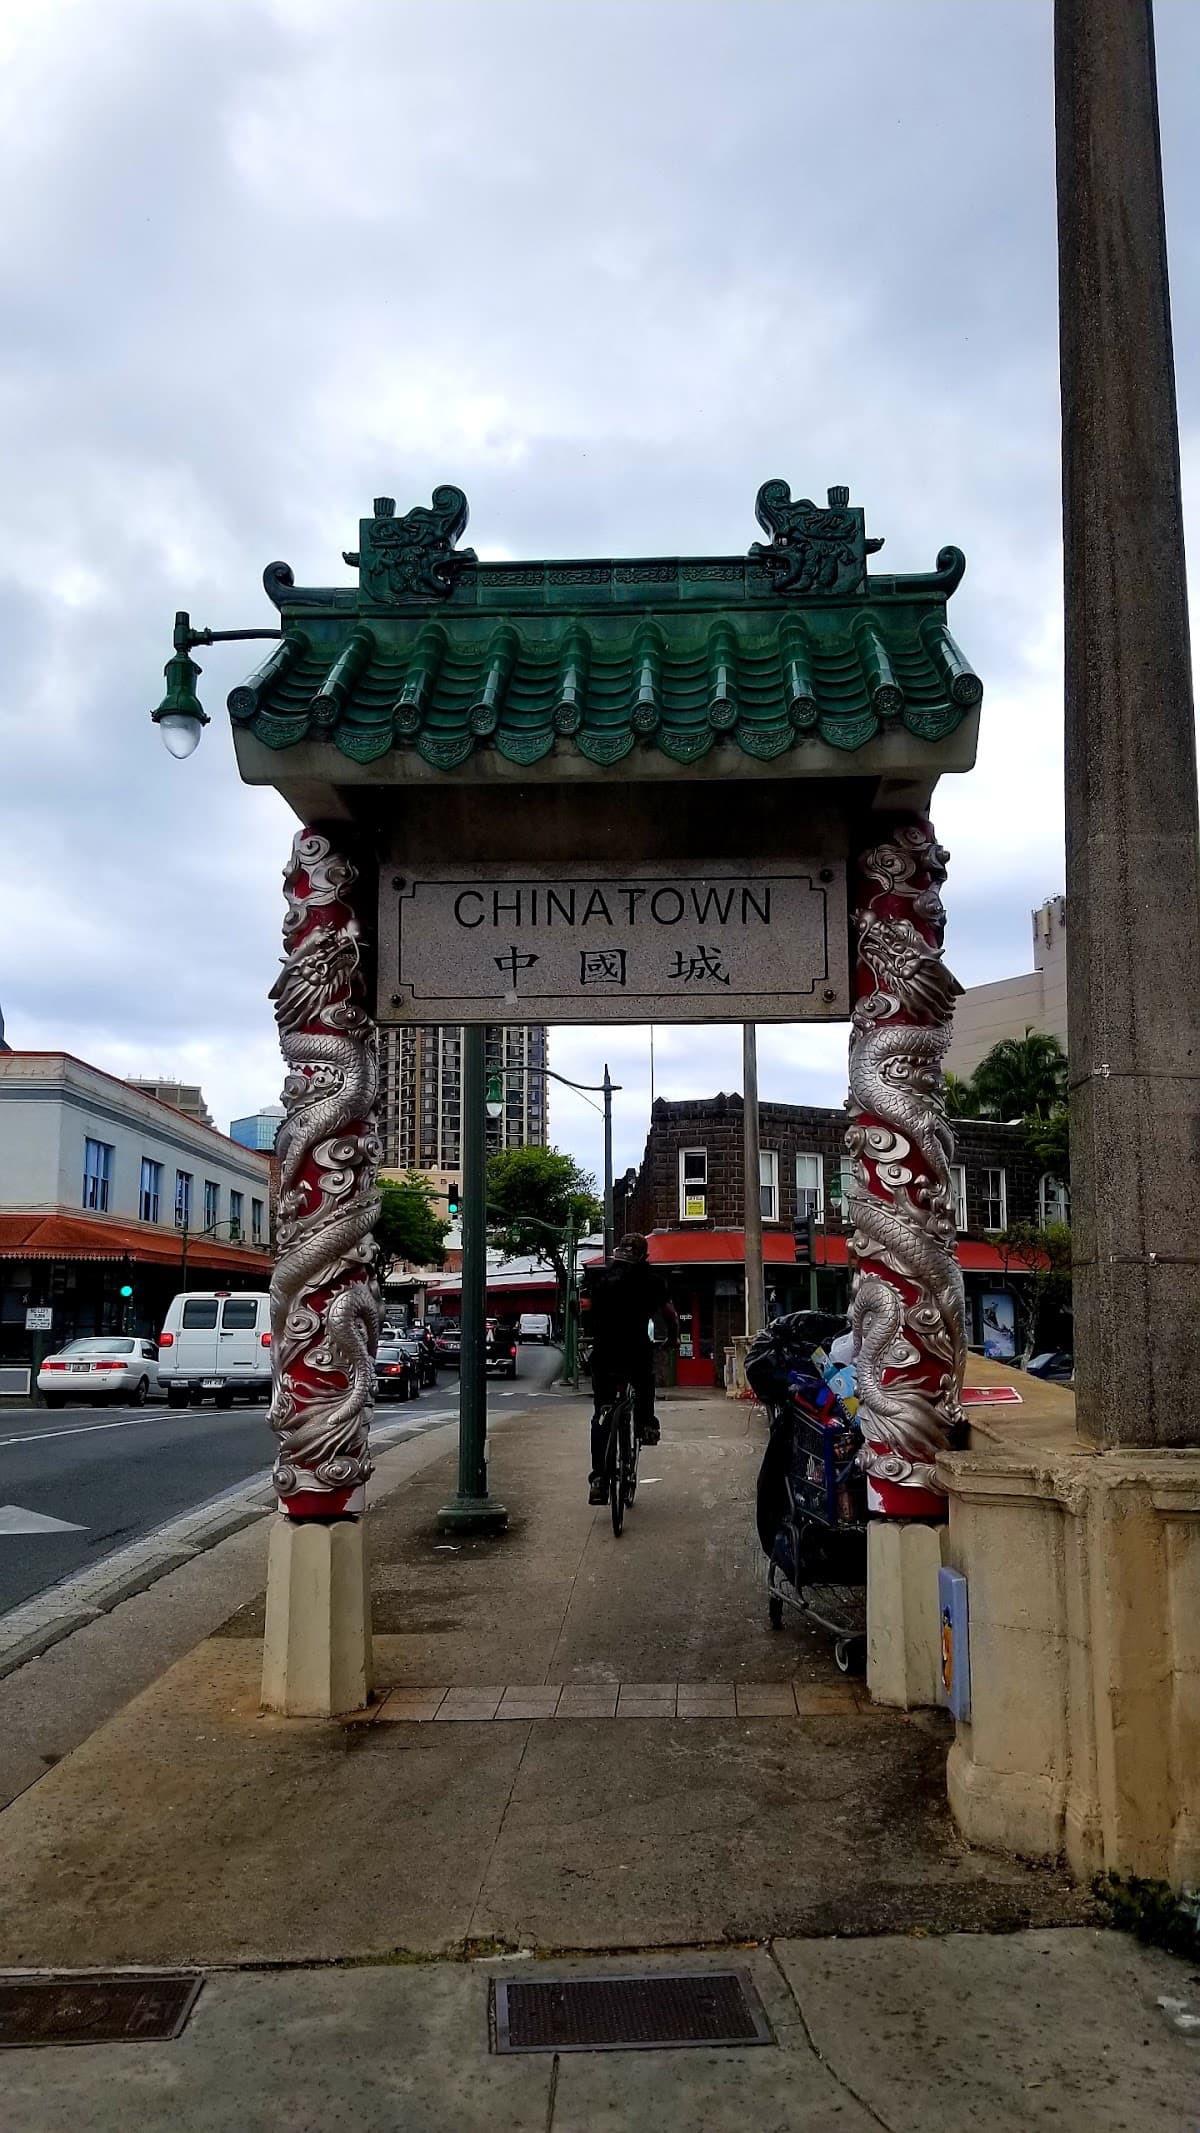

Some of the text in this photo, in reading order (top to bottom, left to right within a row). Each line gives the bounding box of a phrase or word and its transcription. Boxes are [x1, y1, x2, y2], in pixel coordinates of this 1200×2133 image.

[454, 887, 771, 928] CHINATOWN
[494, 945, 730, 988] 中國城
